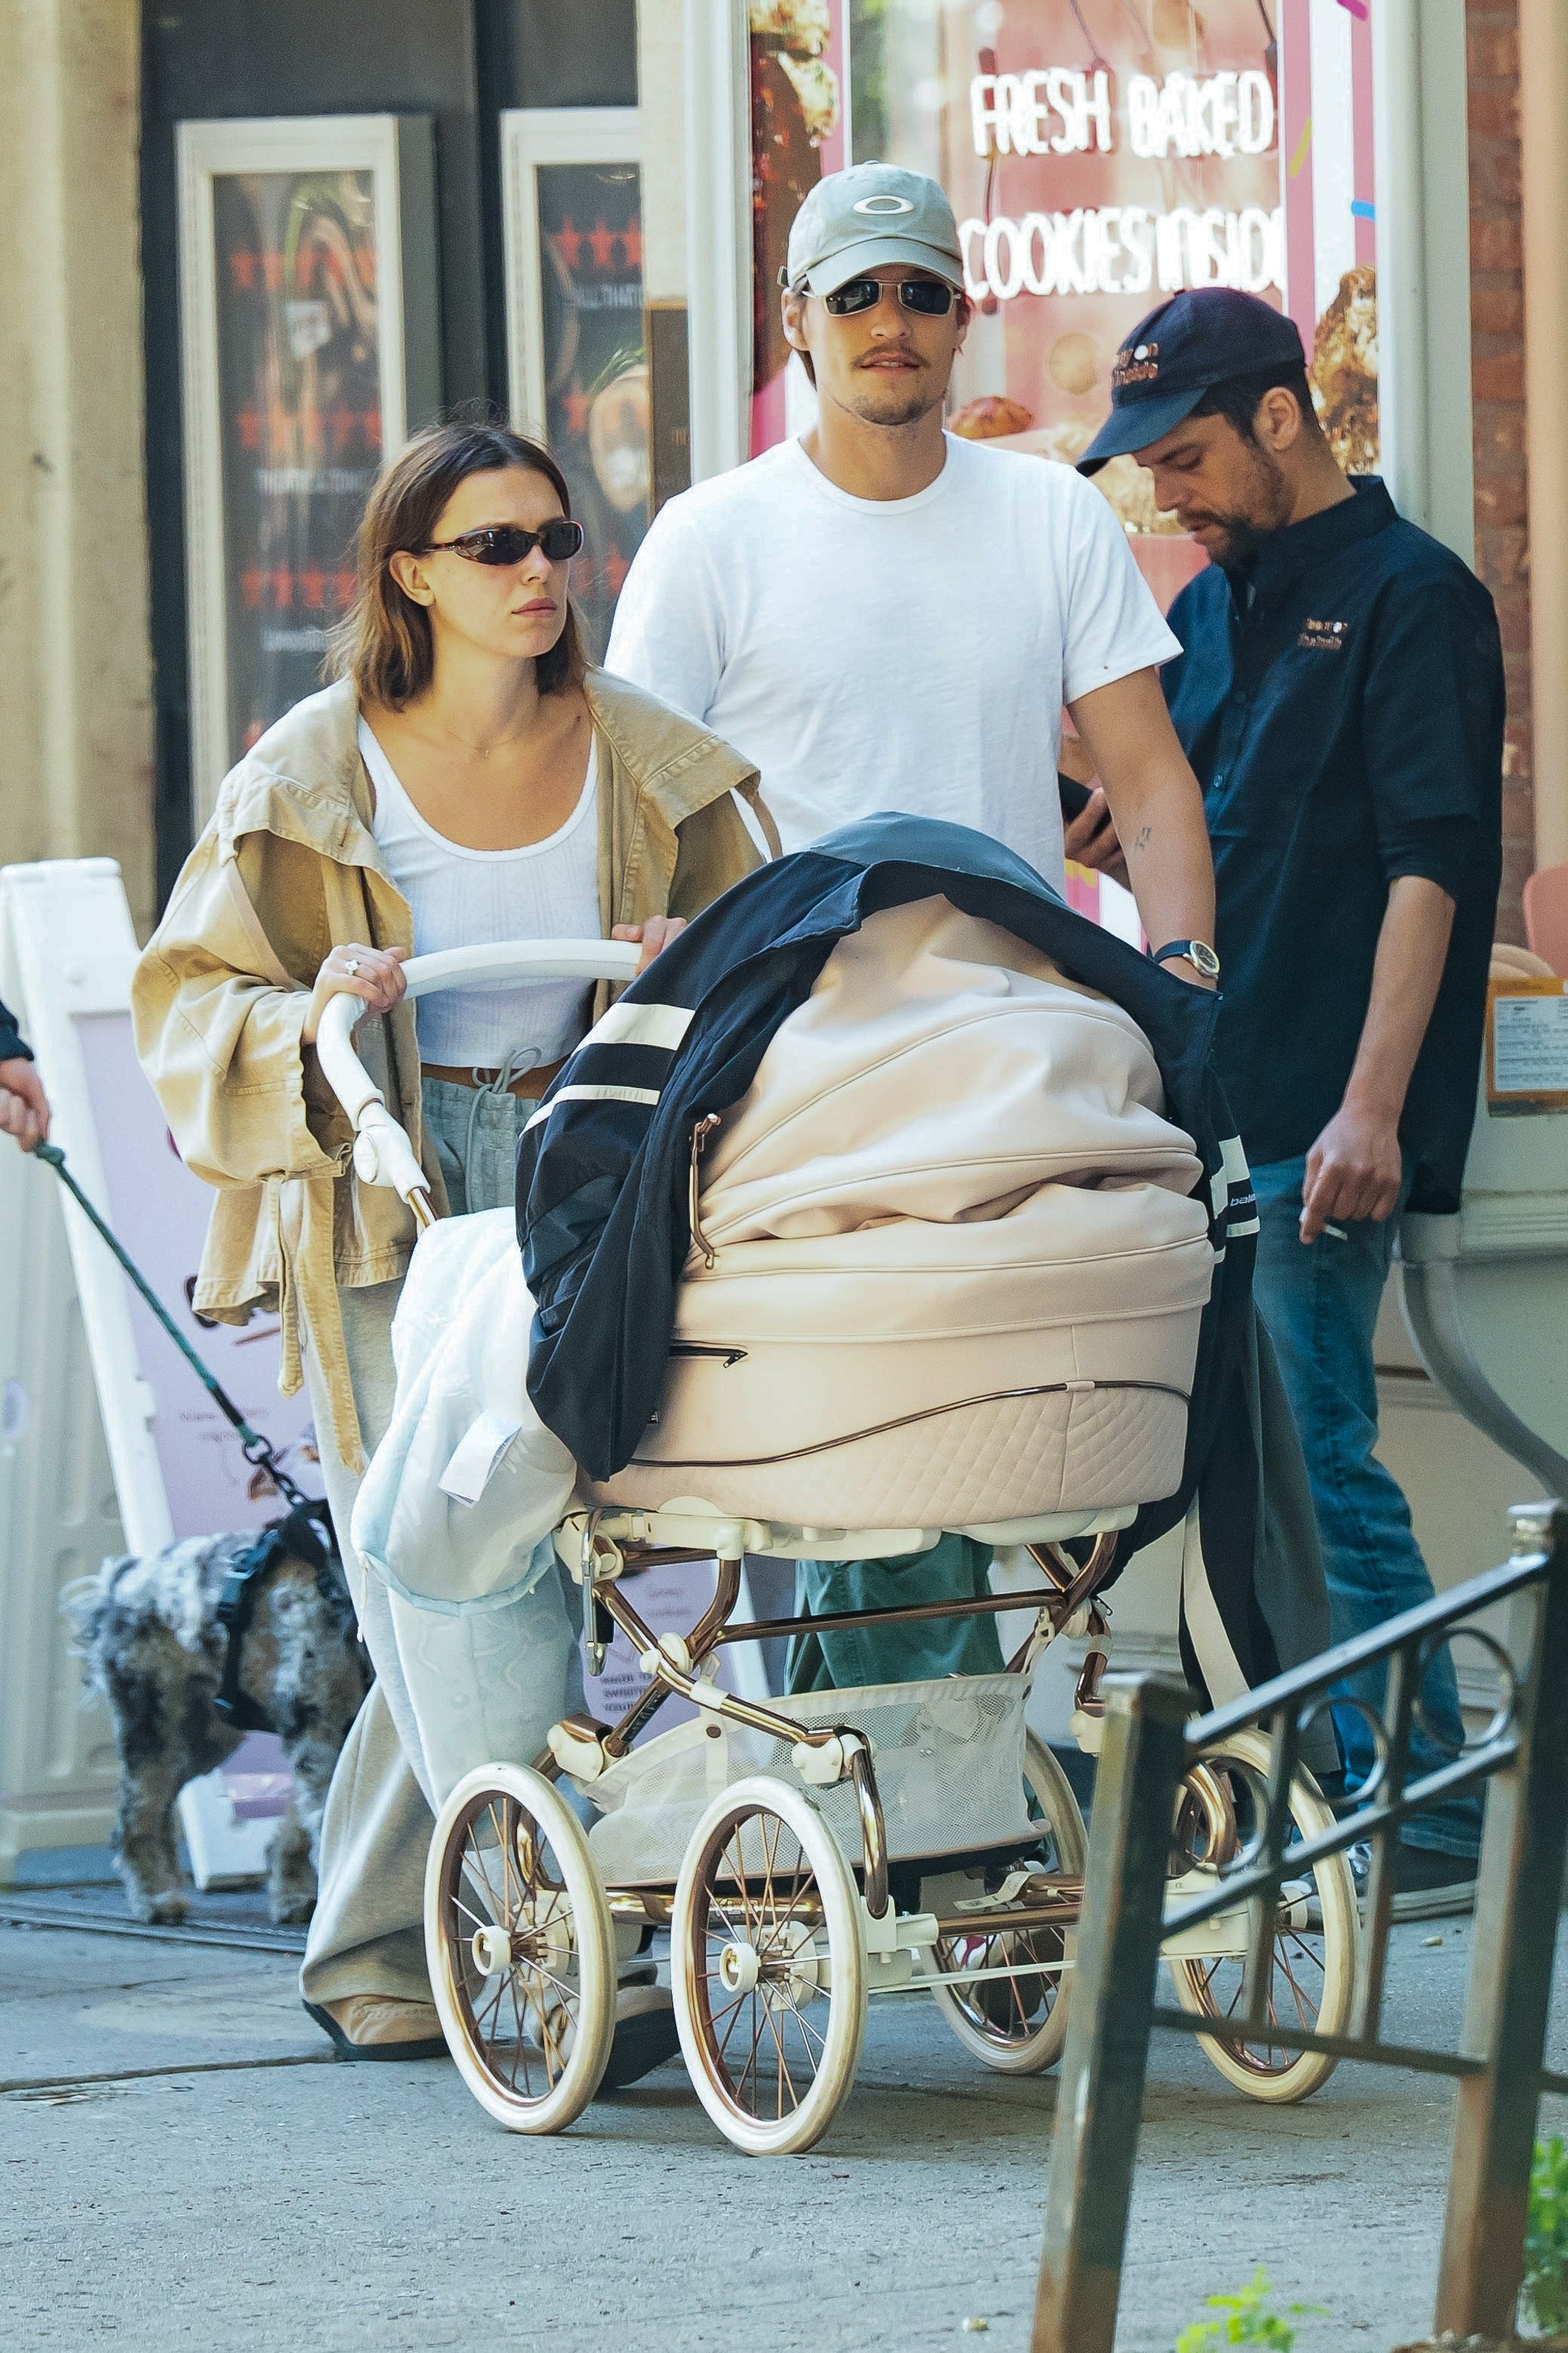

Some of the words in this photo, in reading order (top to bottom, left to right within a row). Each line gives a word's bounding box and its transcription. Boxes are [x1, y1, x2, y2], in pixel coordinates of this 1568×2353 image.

[970, 68, 1111, 157] FRESH
[1128, 71, 1274, 158] BAKED
[959, 207, 1152, 299] COOKIES
